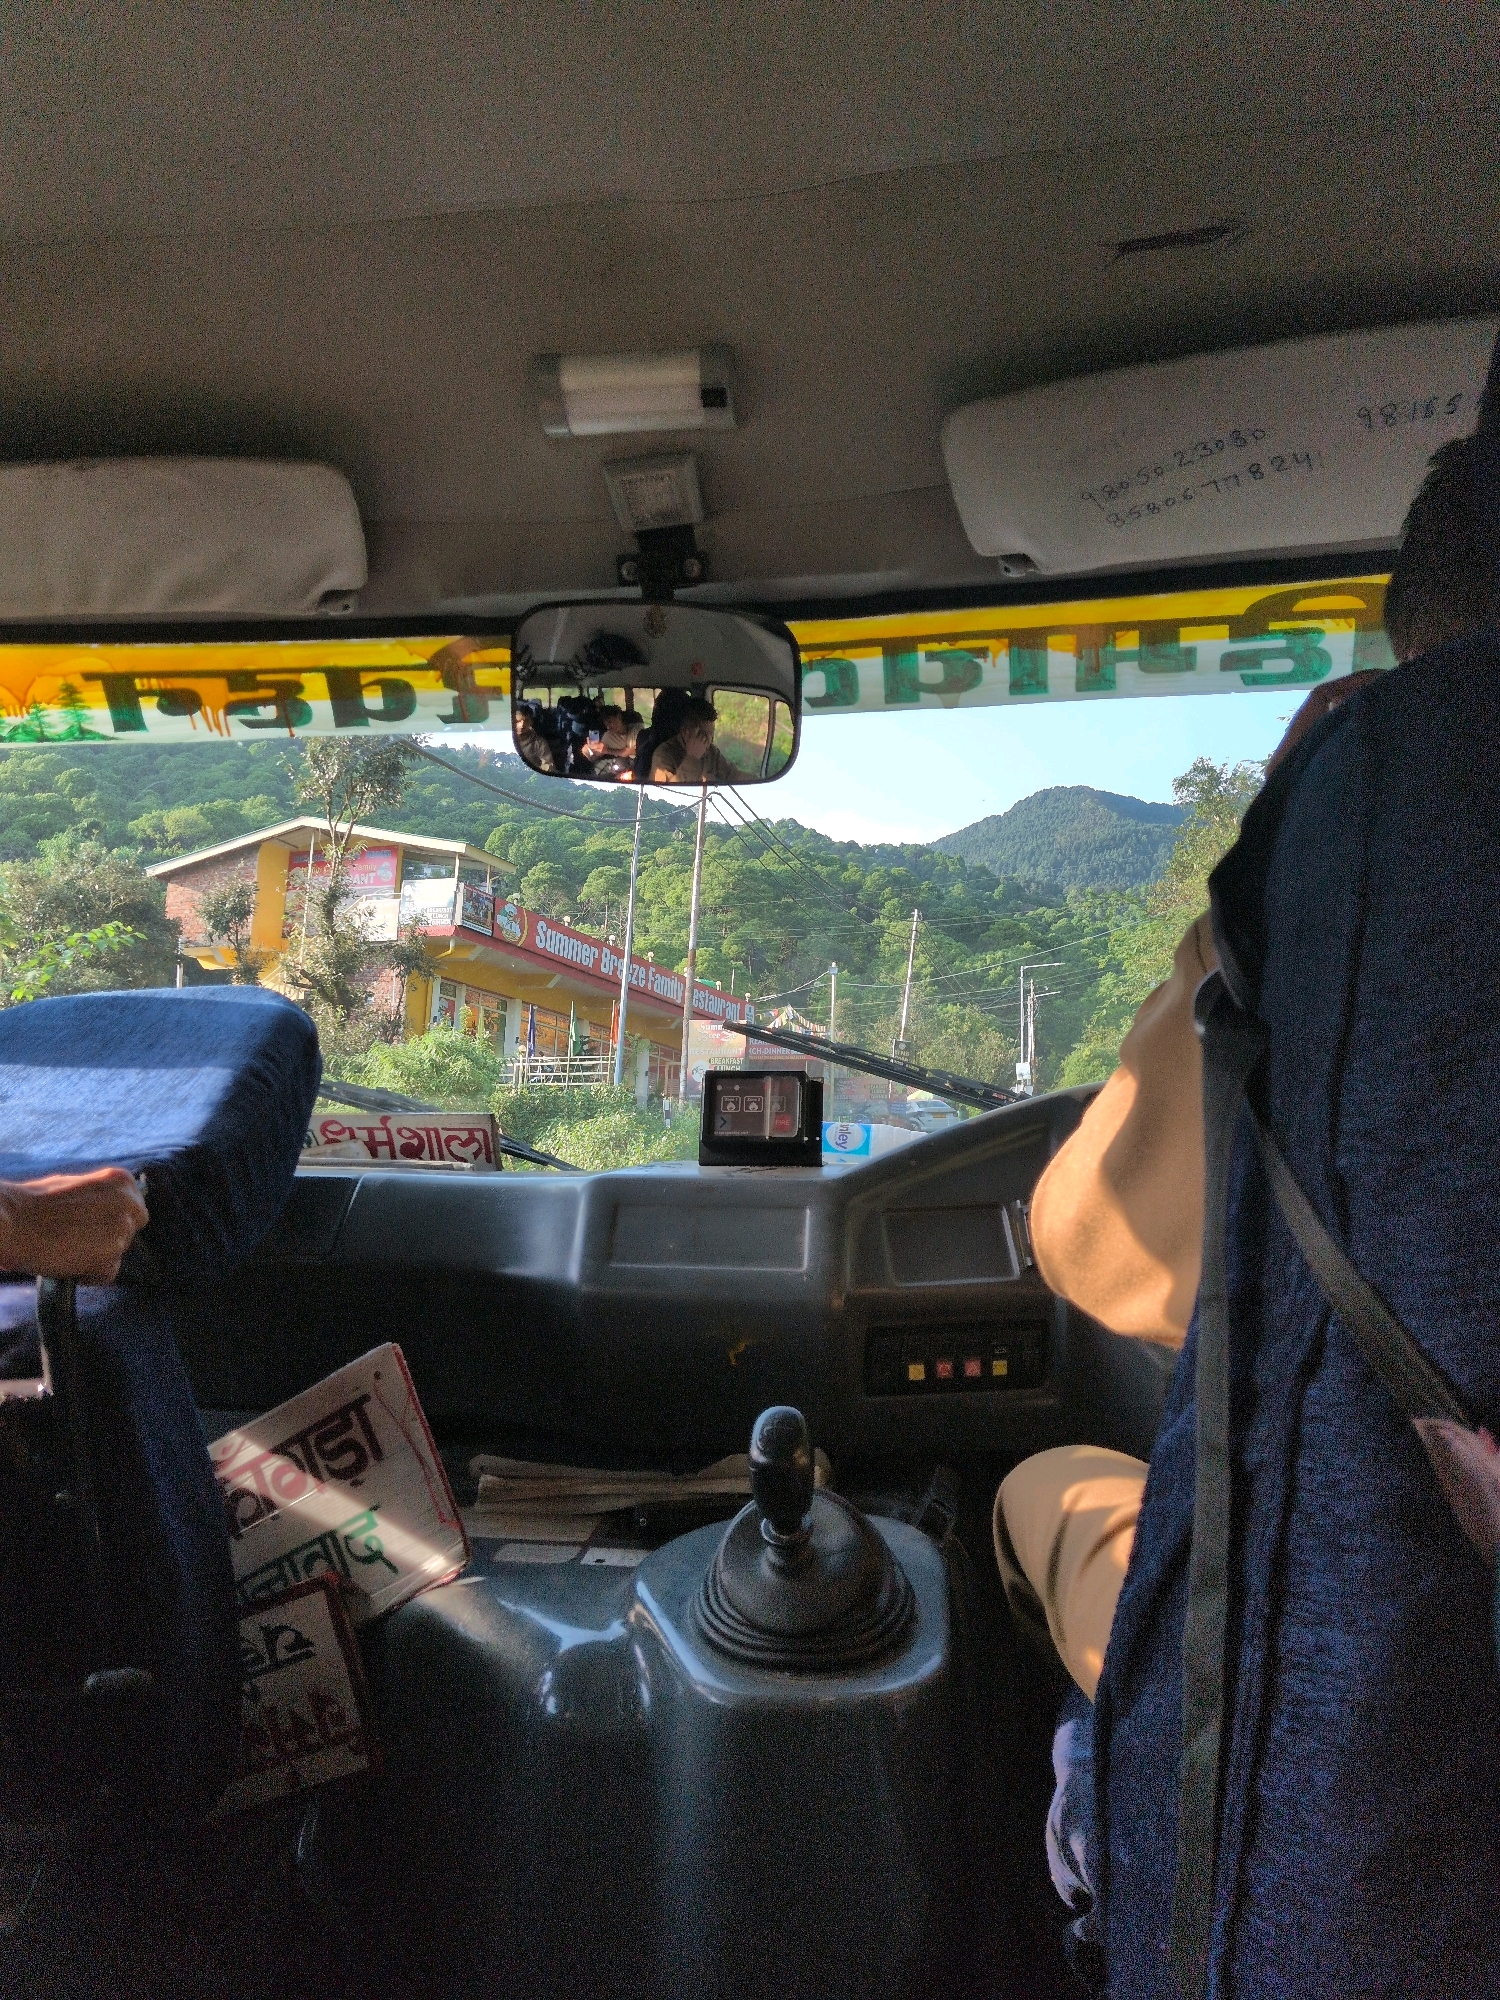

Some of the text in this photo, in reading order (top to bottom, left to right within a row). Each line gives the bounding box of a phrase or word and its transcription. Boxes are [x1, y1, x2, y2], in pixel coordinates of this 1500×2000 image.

[535, 920, 598, 969] Summer
[647, 966, 684, 1004] Family
[692, 988, 741, 1022] estaurant
[710, 1057, 744, 1065] BREAKFAST
